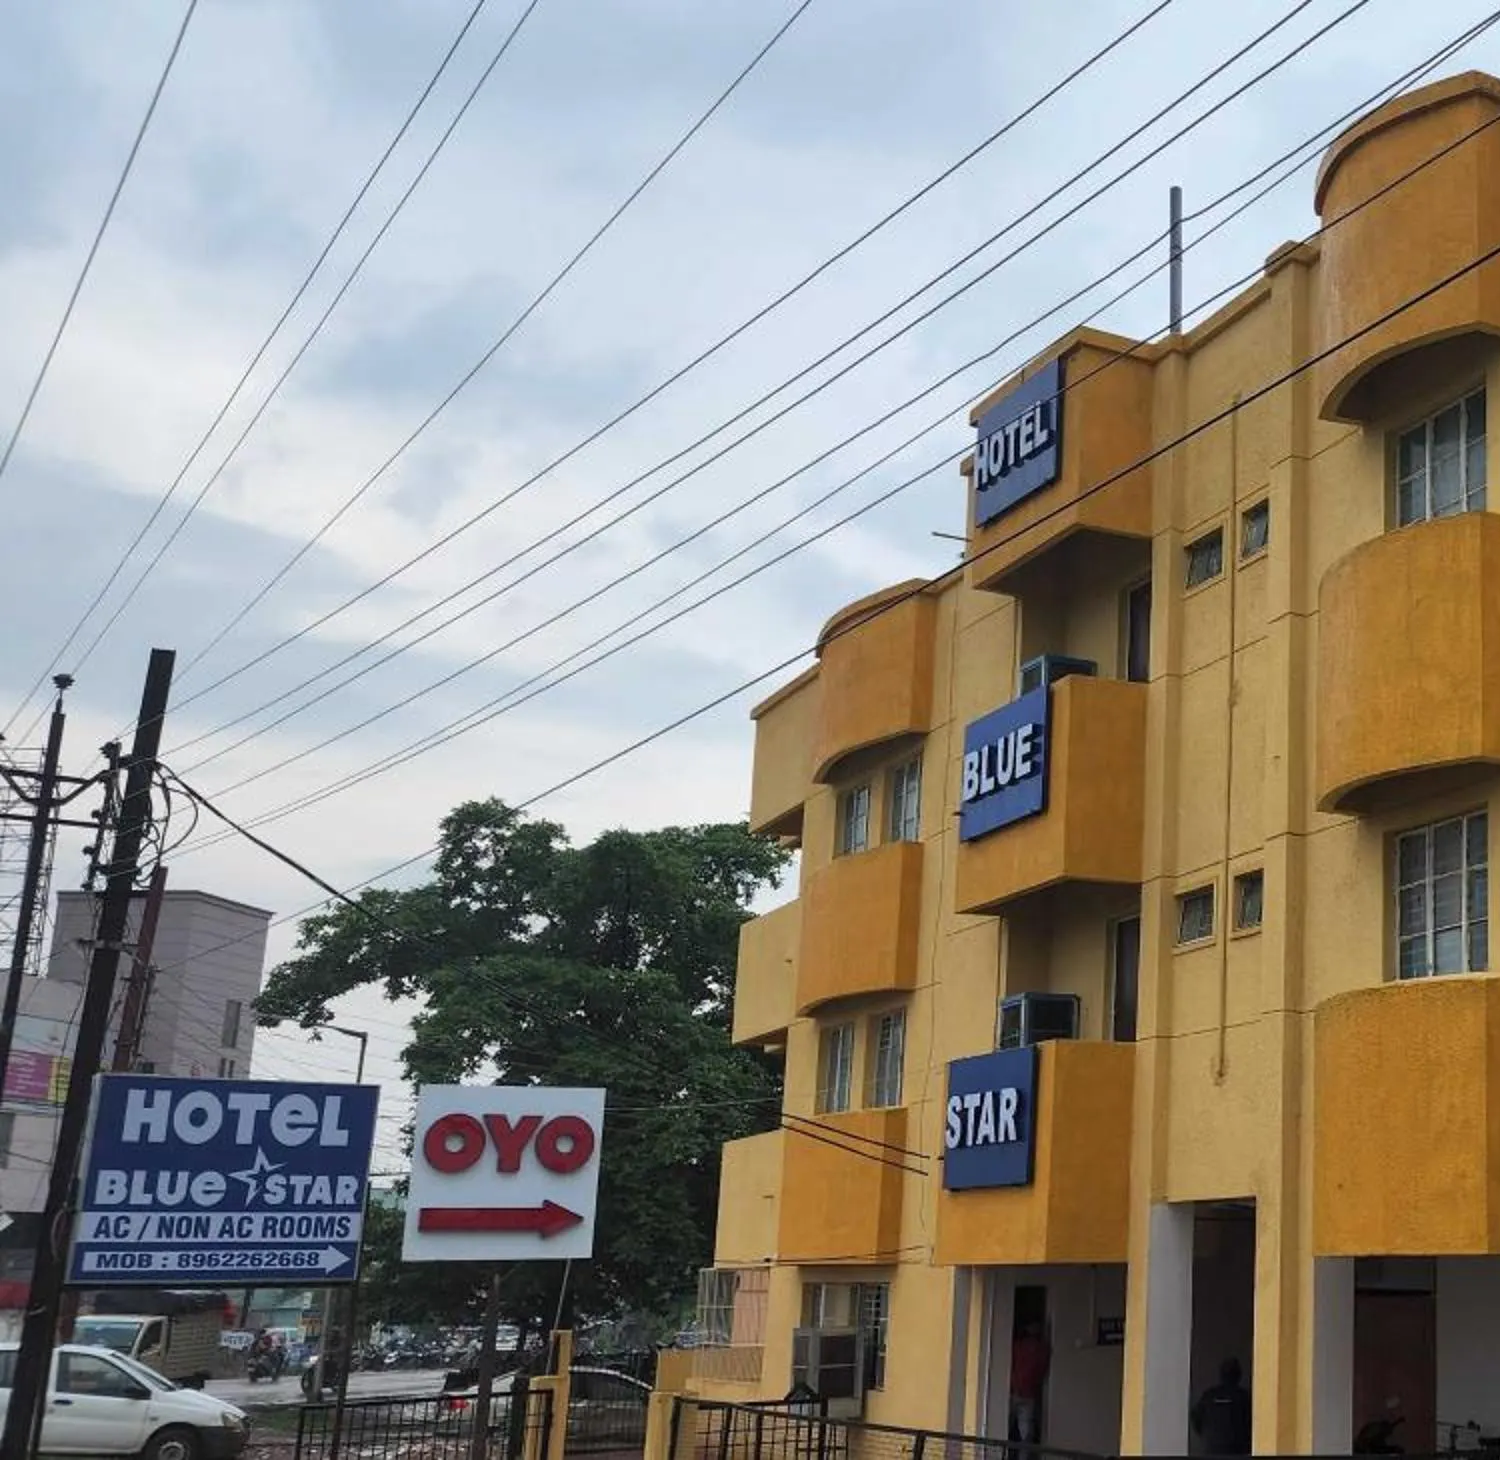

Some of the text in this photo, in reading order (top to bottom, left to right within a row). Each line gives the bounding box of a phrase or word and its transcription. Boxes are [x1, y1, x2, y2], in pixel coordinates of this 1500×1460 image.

[975, 400, 1048, 489] HOTEL
[962, 723, 1033, 801] BLUE
[423, 1113, 595, 1174] OYO
[945, 1087, 1020, 1149] STAR
[263, 1175, 358, 1205] STAR
[93, 1214, 351, 1240] AC / NON AC ROOMS
[95, 1253, 153, 1269] MOB
[177, 1251, 320, 1268] 8962262668
